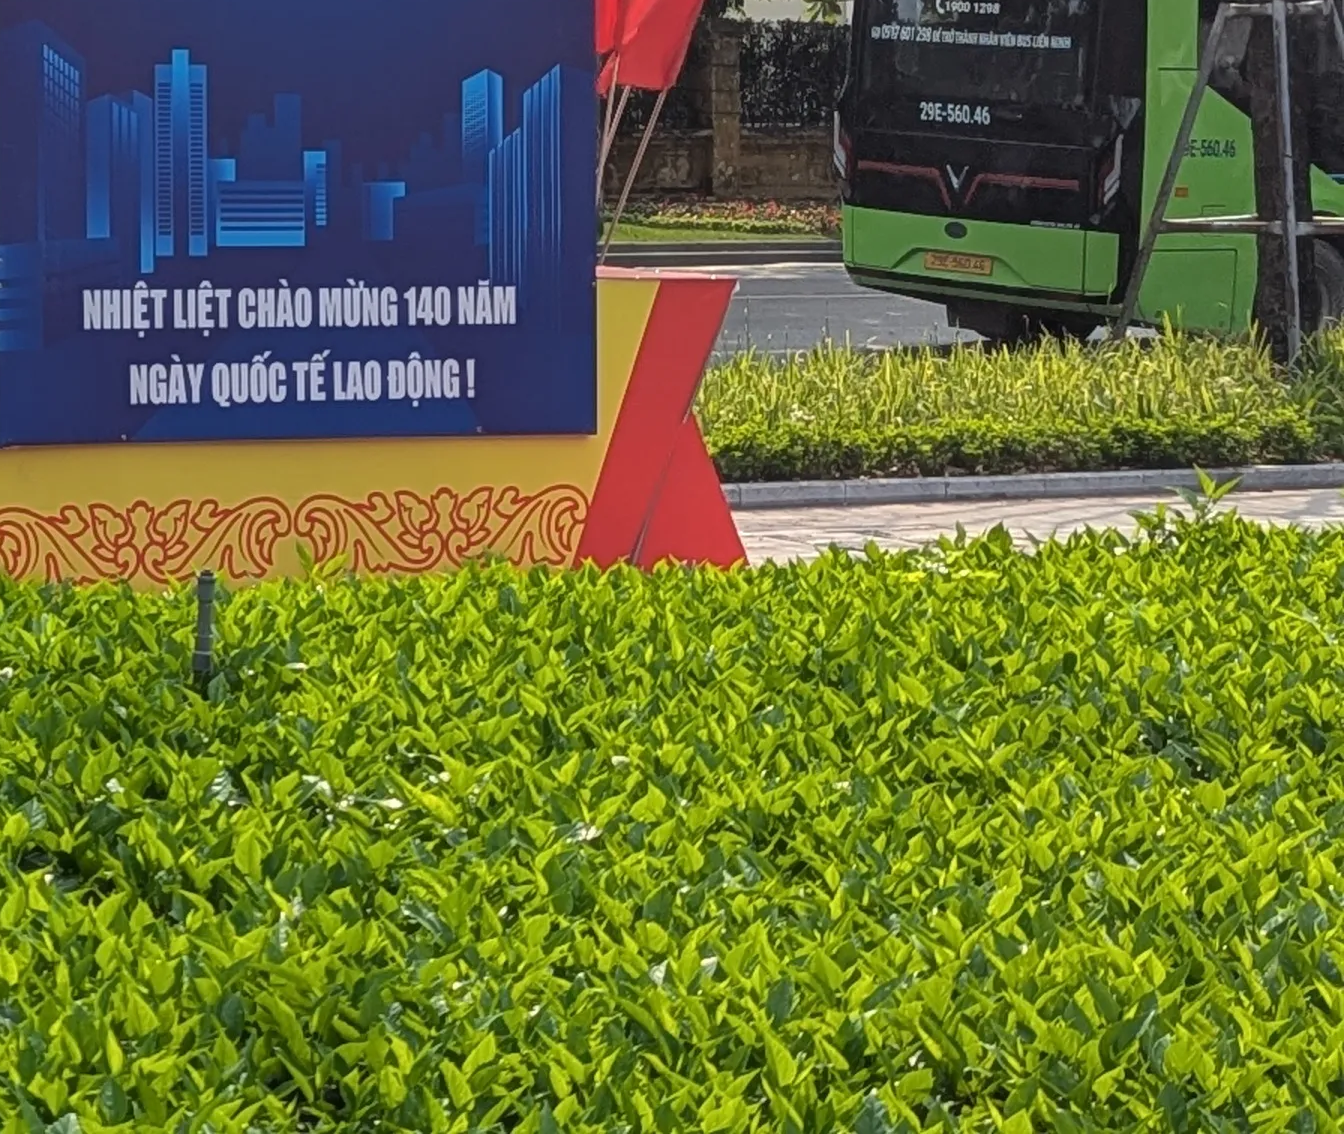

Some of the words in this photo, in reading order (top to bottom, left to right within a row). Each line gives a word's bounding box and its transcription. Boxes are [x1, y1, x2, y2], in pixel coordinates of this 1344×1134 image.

[945, 0, 971, 13] 1900
[919, 101, 991, 126] 29E-560.46
[82, 280, 167, 338] NHIỆT
[173, 280, 232, 337] LIỆT
[237, 278, 312, 329] CHÀO
[318, 279, 398, 327] MỪNG
[403, 286, 452, 325] 140
[457, 278, 517, 325] NĂM
[129, 354, 205, 405] NGÀY
[211, 349, 287, 408] QUỐC
[292, 349, 330, 401] TẾ
[333, 360, 382, 401] LAO
[387, 352, 461, 407] ĐỘNG
